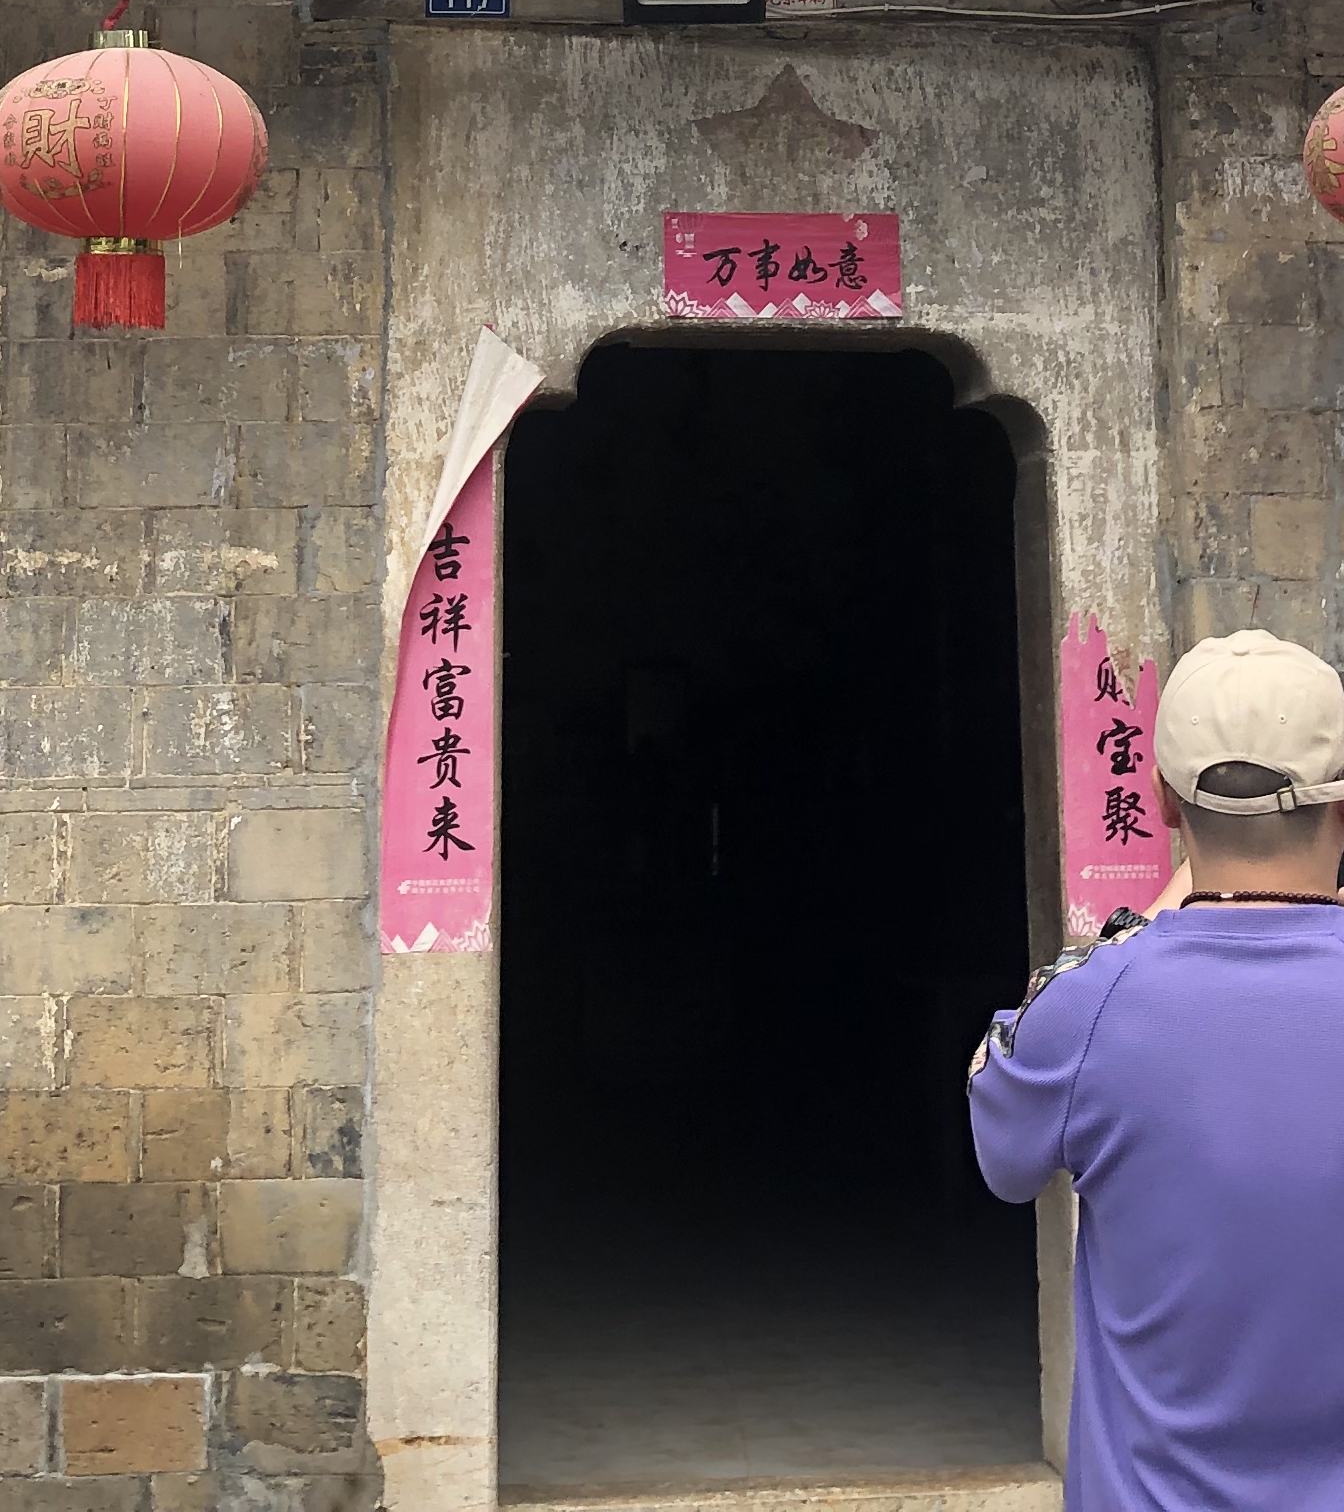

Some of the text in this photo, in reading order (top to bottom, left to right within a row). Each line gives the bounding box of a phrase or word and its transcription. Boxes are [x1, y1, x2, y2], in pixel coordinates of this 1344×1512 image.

[702, 238, 868, 291] 万事如意
[416, 521, 476, 862] 吉祥富贵来
